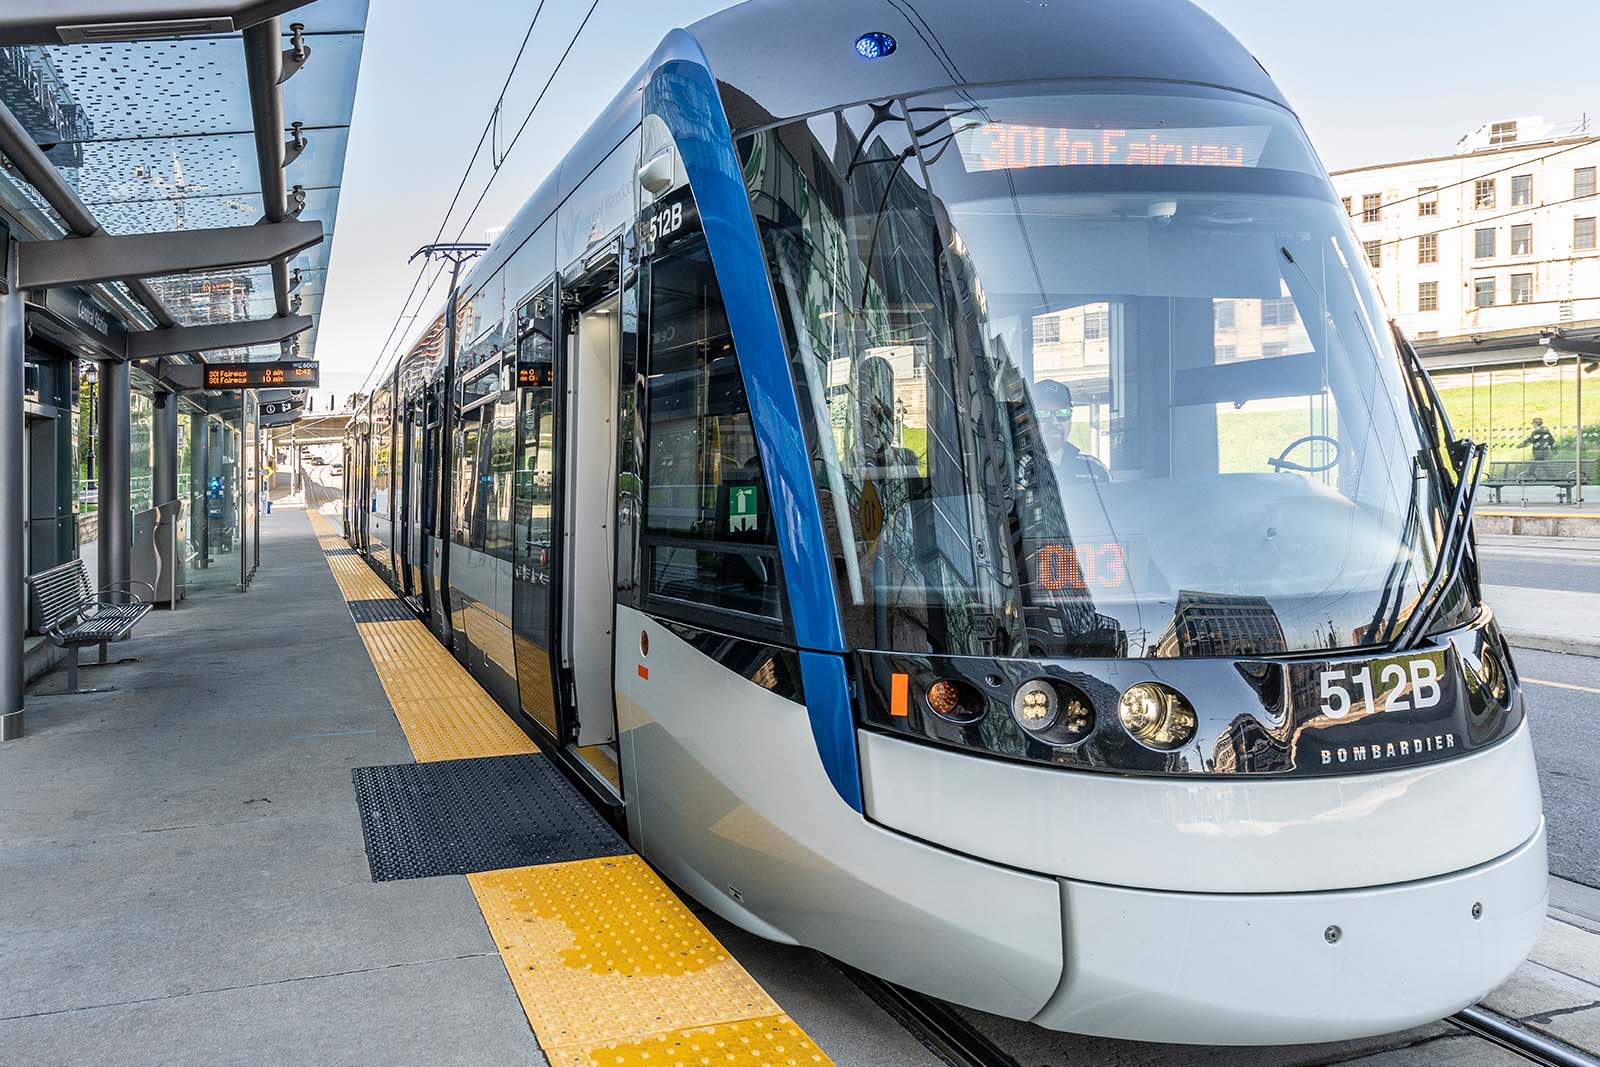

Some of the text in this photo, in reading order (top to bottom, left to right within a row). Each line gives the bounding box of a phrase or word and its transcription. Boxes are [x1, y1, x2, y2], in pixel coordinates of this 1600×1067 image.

[980, 122, 1044, 169] 301
[650, 202, 682, 242] 512B
[263, 375, 272, 383] 10
[1320, 658, 1441, 719] 512B
[1320, 733, 1455, 764] BOMBARDIER
